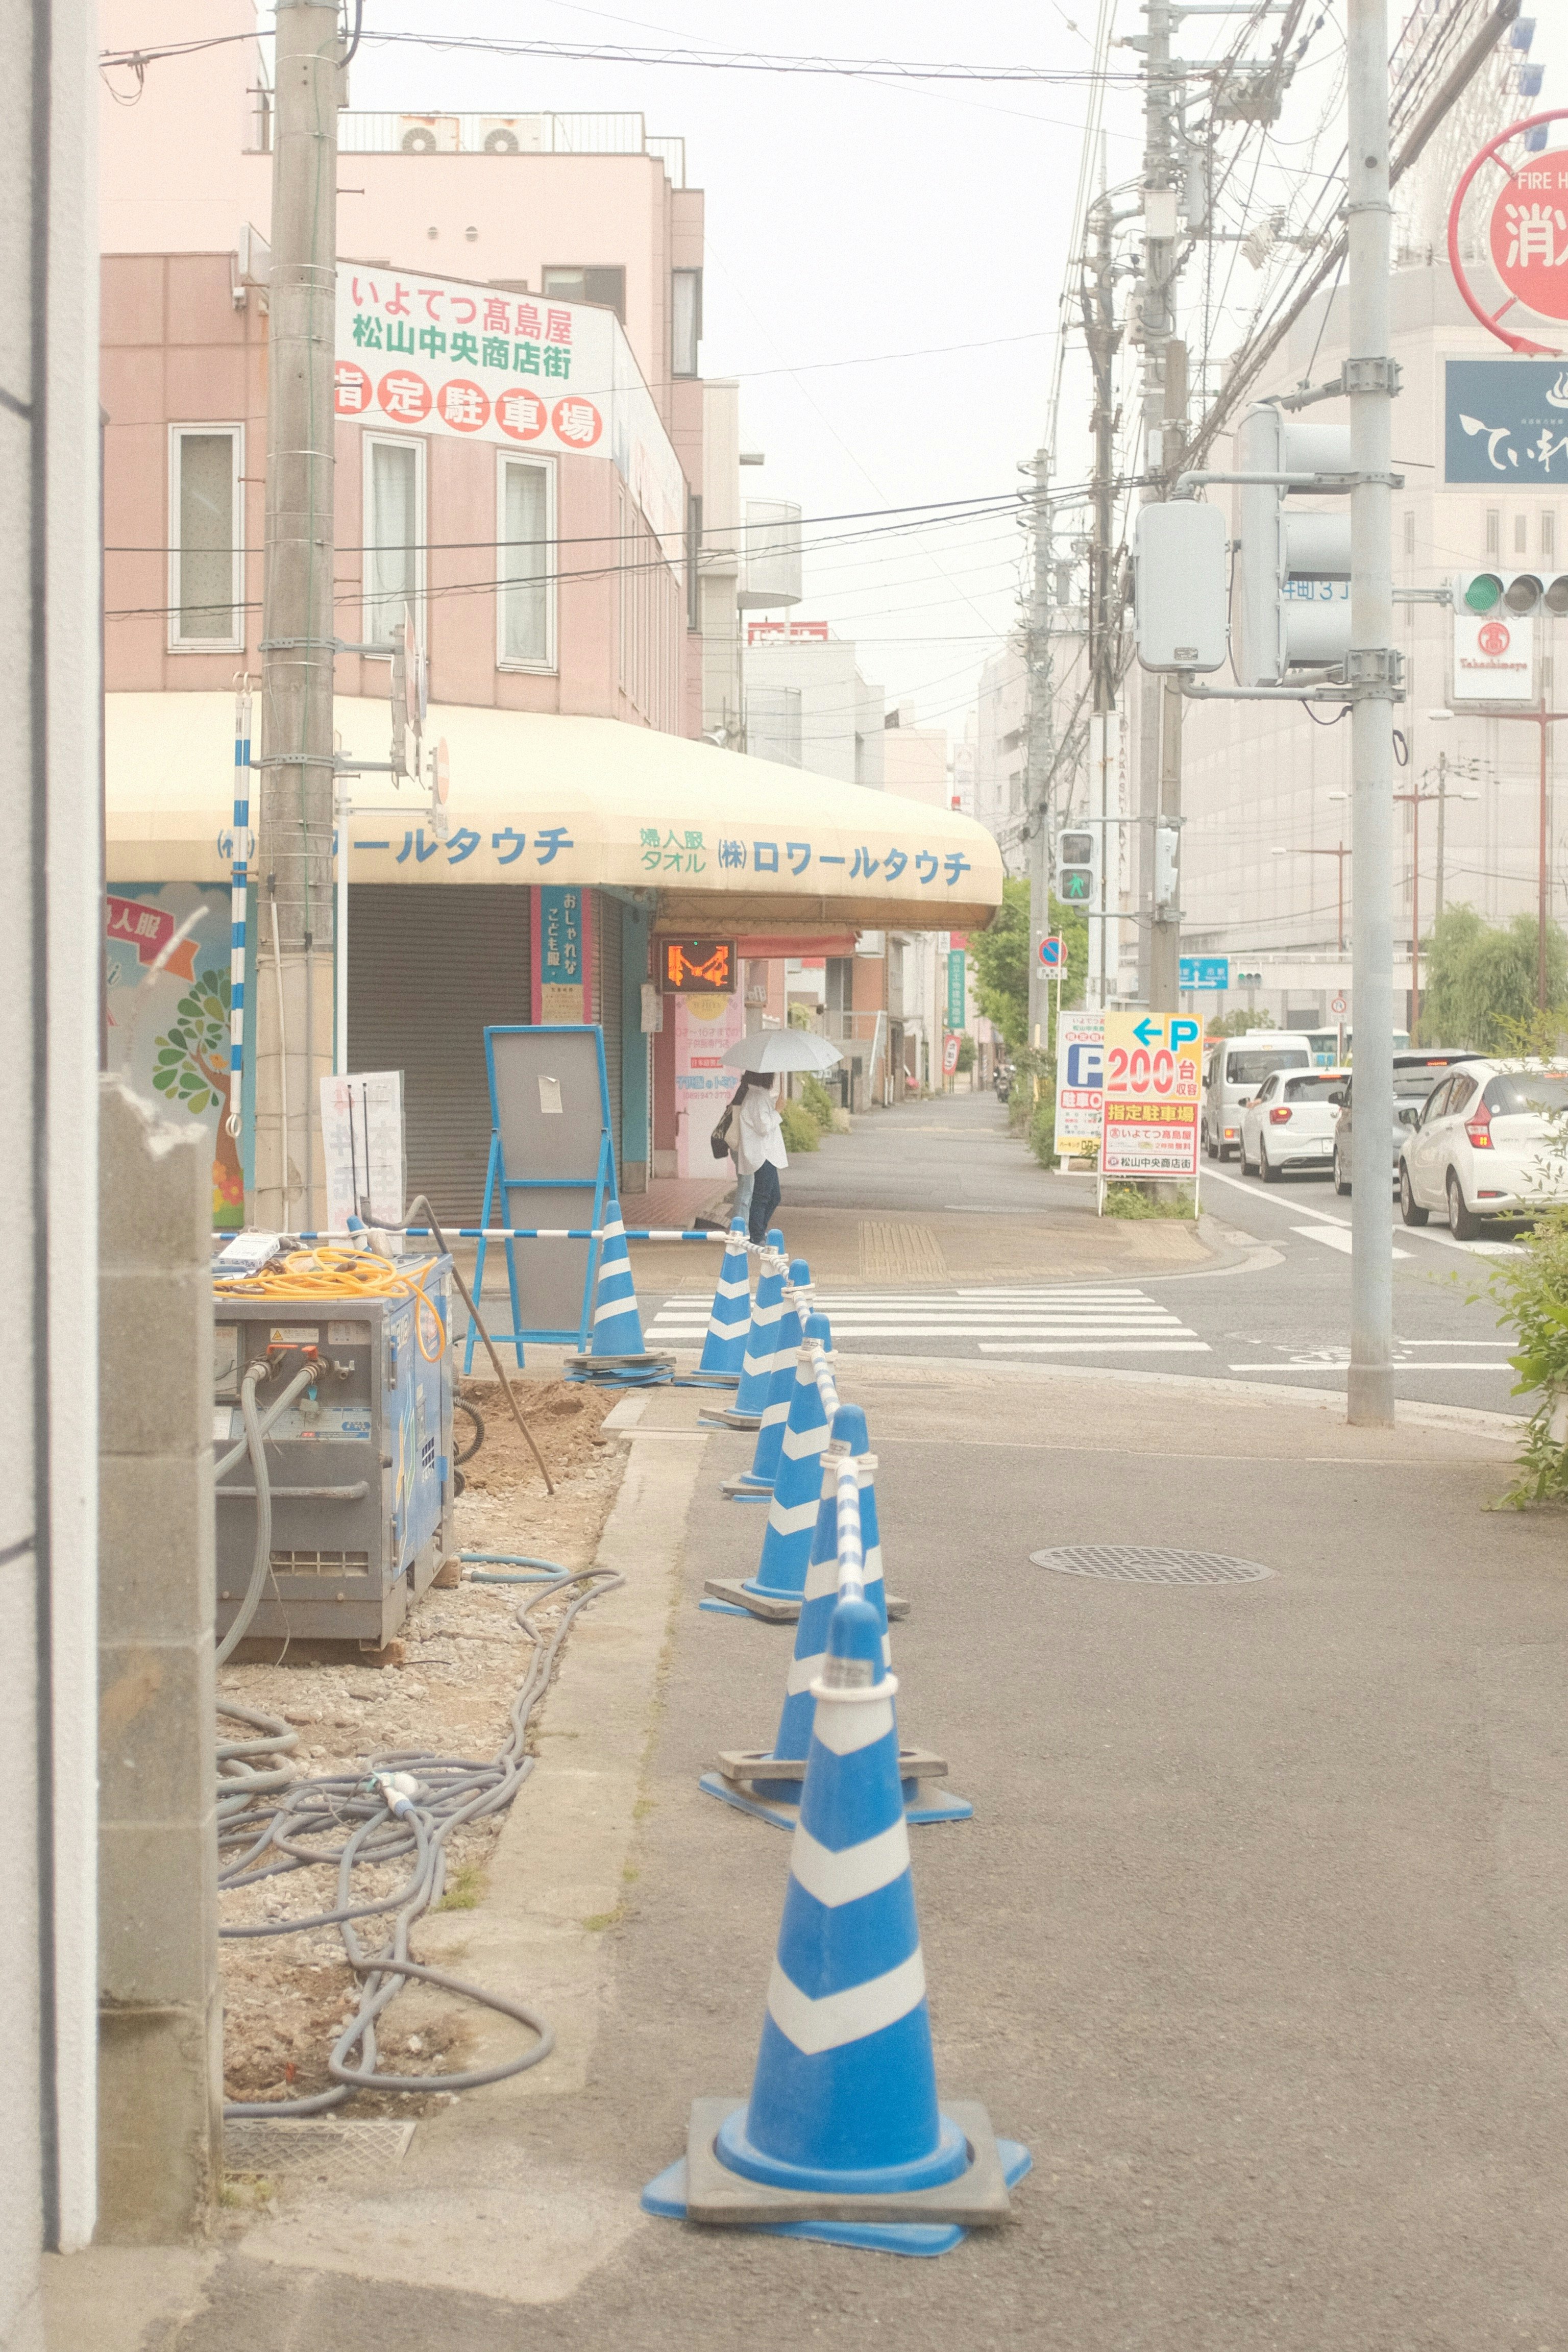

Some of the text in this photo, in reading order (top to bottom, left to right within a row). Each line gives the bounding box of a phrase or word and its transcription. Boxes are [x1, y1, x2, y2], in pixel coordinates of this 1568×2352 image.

[1517, 172, 1552, 189] FIRE
[352, 313, 571, 380] 松山中央商店街
[335, 368, 598, 443] 指定駐車場
[640, 828, 706, 850] 婦人服
[641, 851, 706, 873] タオル
[107, 904, 161, 940] 人服
[564, 894, 577, 975] おしゃれな
[1171, 1020, 1198, 1052] P
[1107, 1048, 1196, 1094] 200 台
[1175, 1083, 1198, 1096] 収容
[1108, 1104, 1195, 1123] 指定駐車場
[1121, 1158, 1191, 1169] 松山中央商店街
